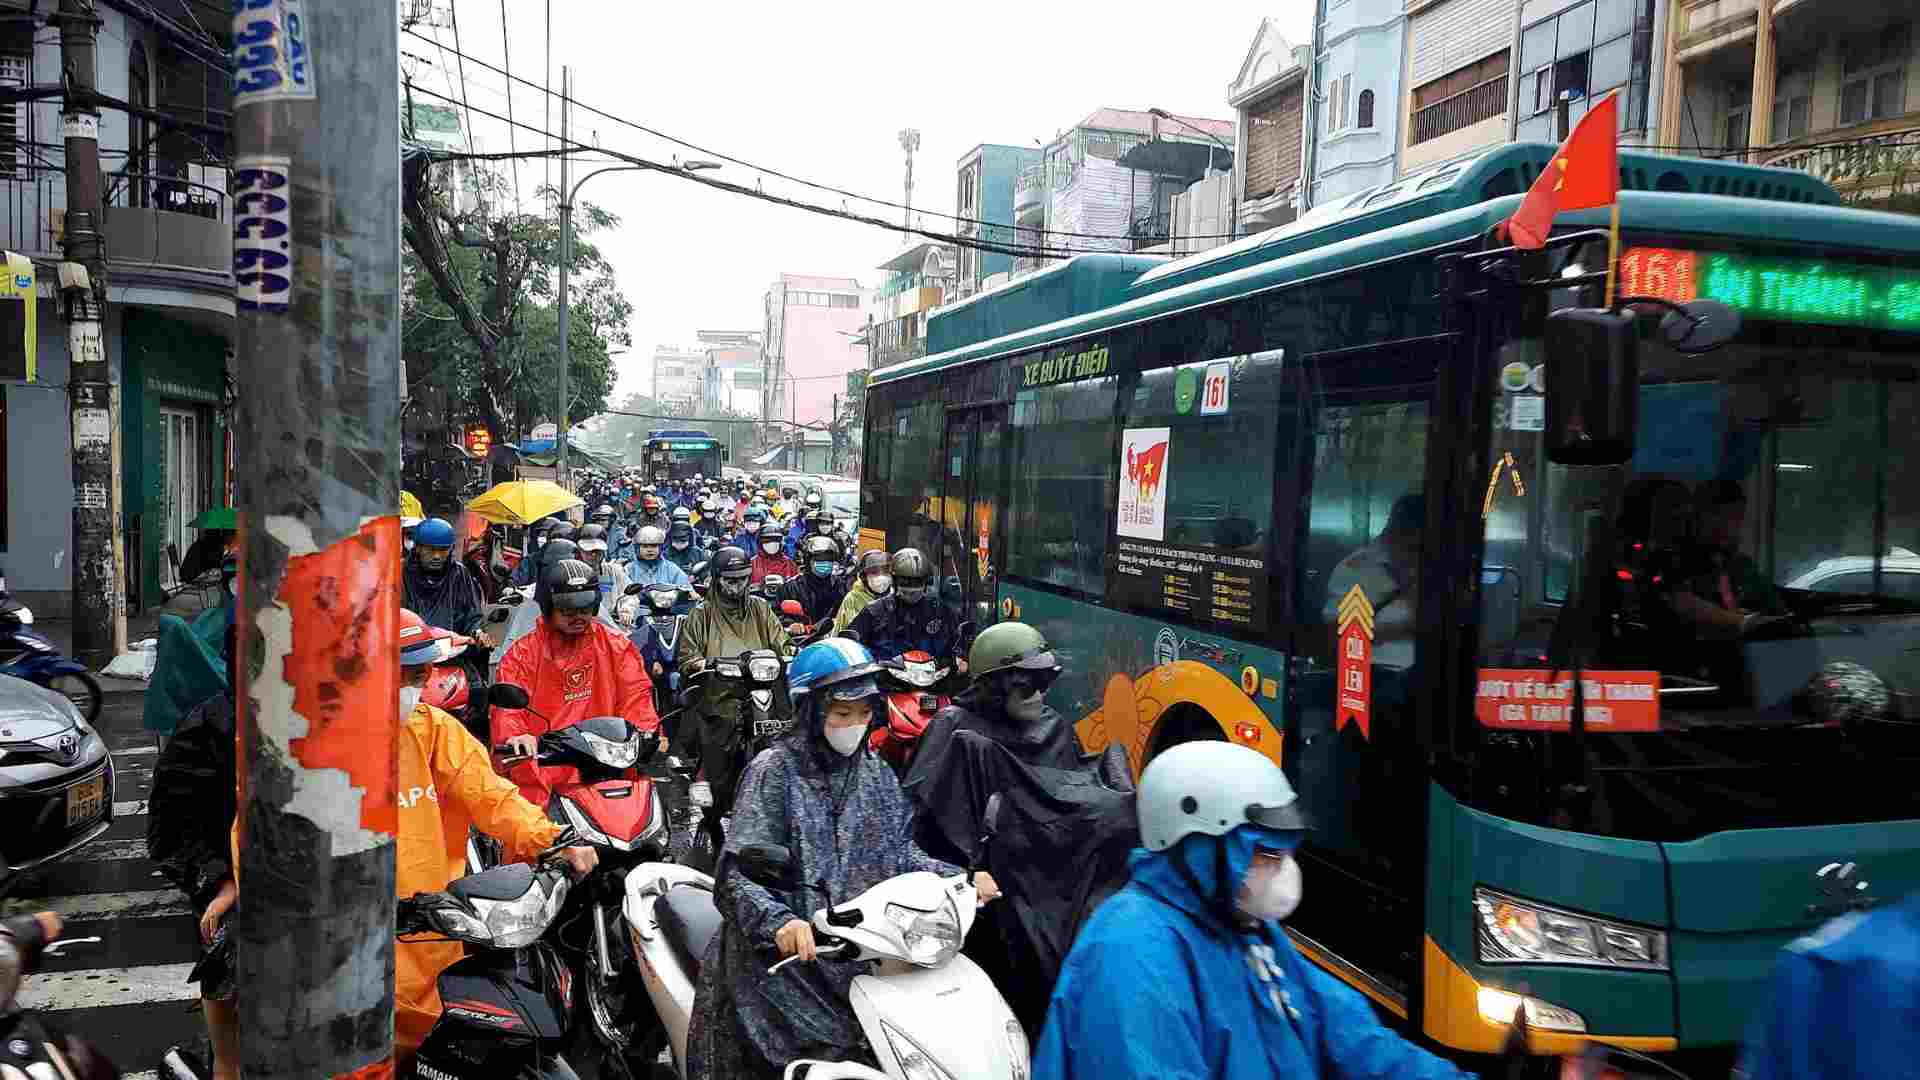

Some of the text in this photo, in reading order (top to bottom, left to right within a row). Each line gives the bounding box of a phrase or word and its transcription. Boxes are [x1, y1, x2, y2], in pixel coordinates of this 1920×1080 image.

[1624, 253, 1690, 304] 161
[1023, 359, 1040, 385] XE
[1204, 374, 1226, 409] 161
